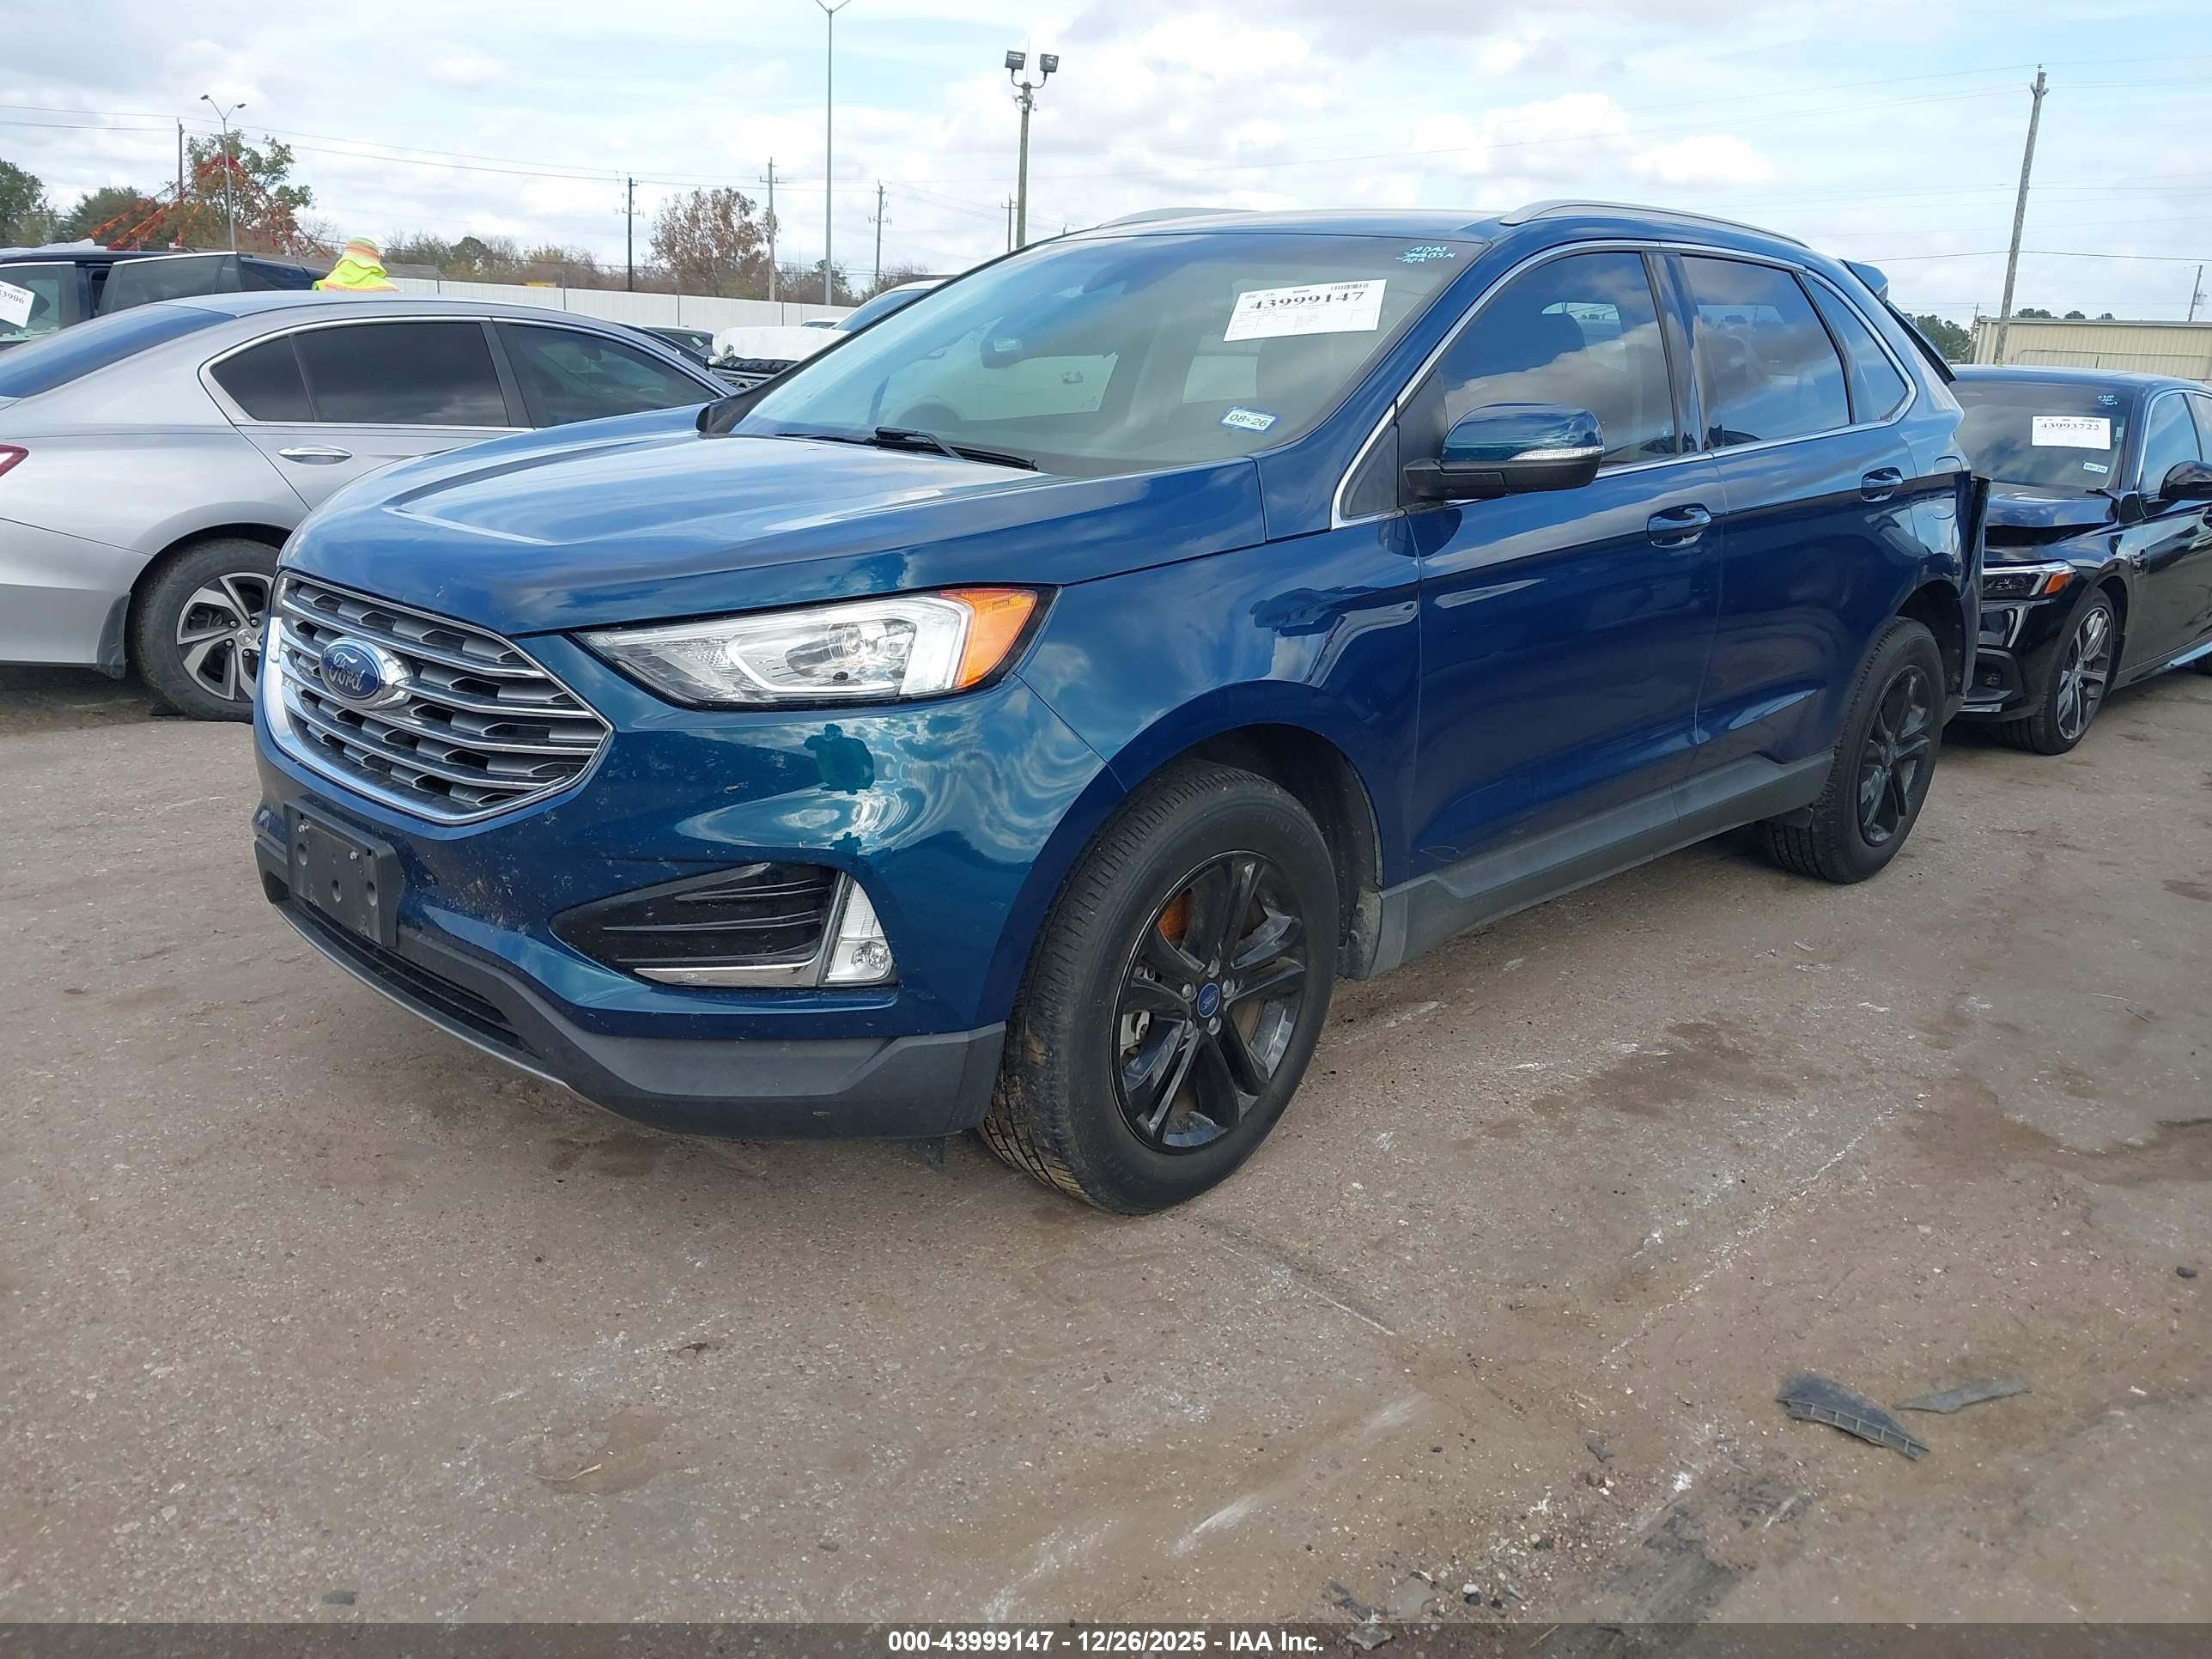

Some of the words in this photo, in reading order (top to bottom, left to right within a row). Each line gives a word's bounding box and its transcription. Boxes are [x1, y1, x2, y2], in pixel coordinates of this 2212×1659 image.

[0, 289, 25, 304] 3906
[1249, 291, 1365, 311] 43999147
[2041, 422, 2100, 431] 43993722
[328, 652, 367, 691] Ford
